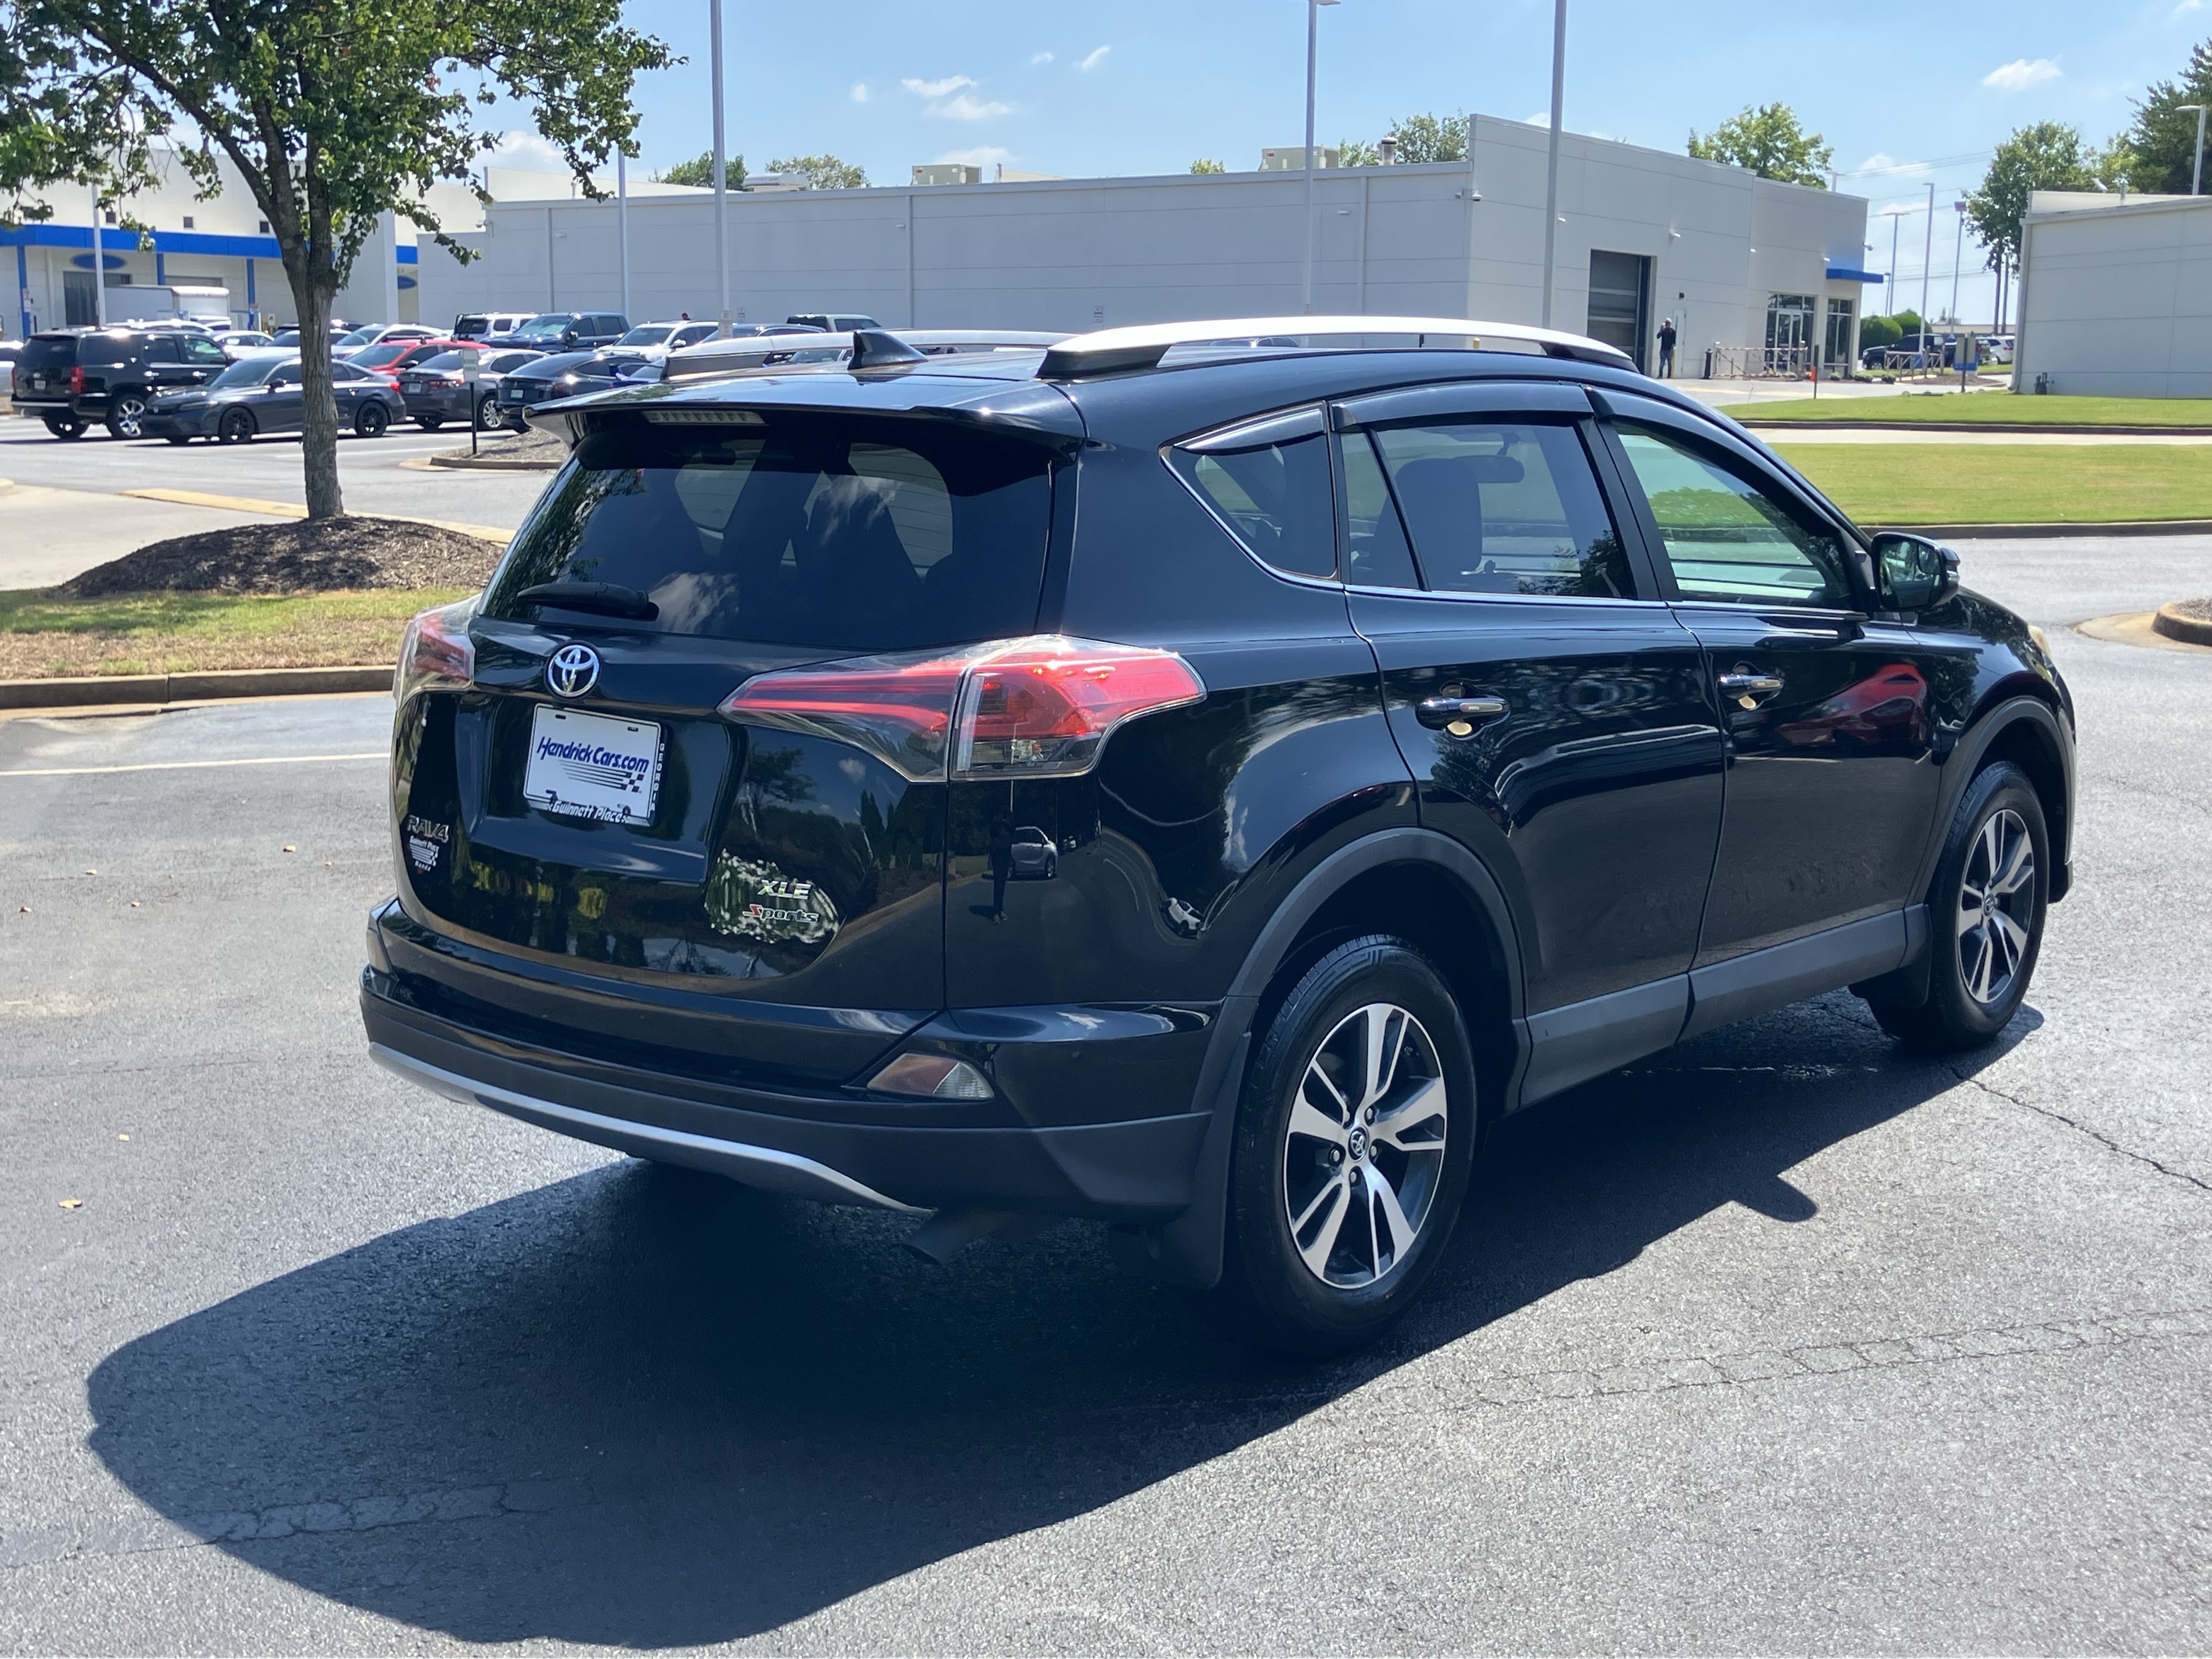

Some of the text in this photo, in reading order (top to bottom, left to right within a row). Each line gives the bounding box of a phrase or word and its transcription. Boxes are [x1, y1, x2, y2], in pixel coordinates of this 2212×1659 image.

[537, 736, 649, 772] HendrickCars.com
[651, 743, 665, 811] GEORGIA
[552, 801, 622, 822] Gwinnett Place
[407, 815, 449, 843] RAV4
[757, 879, 811, 900] XLE
